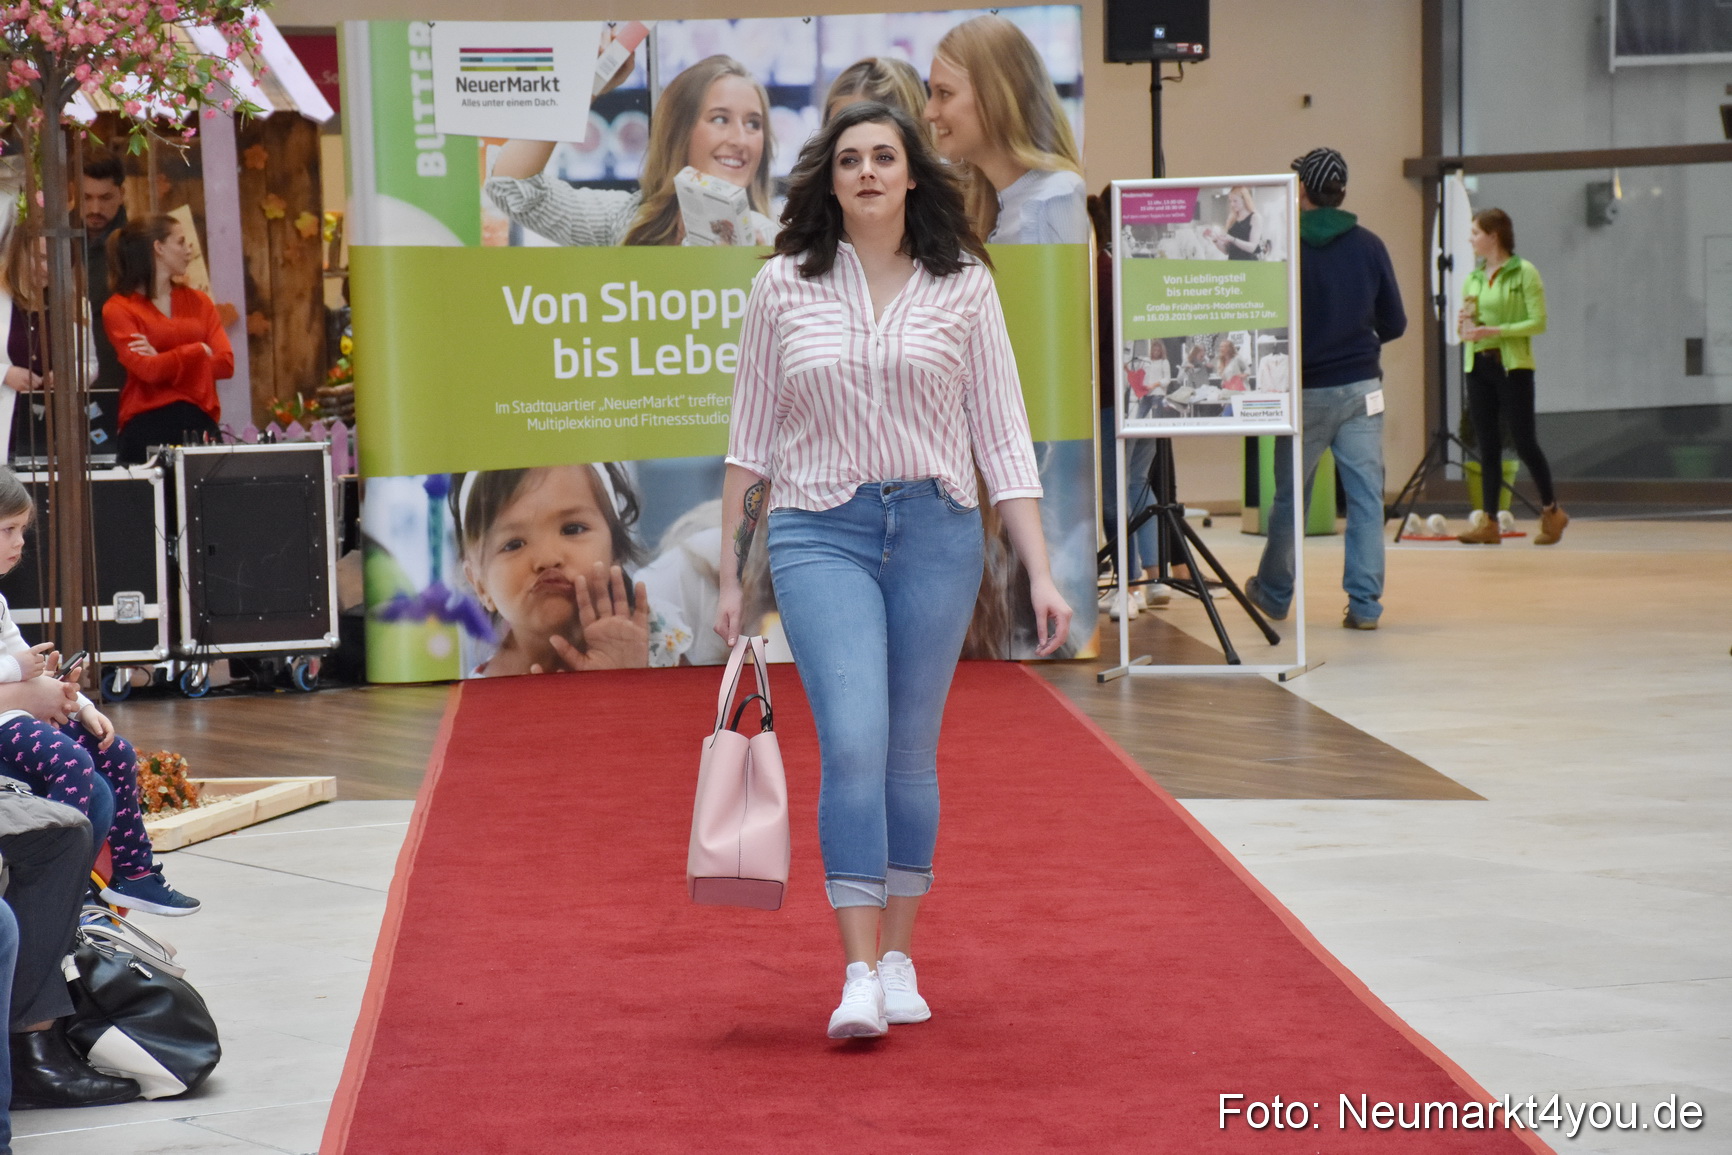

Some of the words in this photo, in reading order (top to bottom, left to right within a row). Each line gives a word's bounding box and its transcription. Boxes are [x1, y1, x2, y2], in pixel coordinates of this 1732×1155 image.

[456, 76, 560, 93] NeuerMarkt
[461, 98, 481, 107] Alles
[482, 98, 504, 107] unter
[506, 98, 533, 107] einem
[534, 98, 559, 107] Dach.
[1163, 275, 1183, 285] Von
[1184, 273, 1247, 285] Lieblingsteil
[1166, 287, 1181, 297] bis
[1183, 287, 1212, 296] neuer
[1214, 285, 1243, 297] Style.
[502, 285, 588, 325] Von
[600, 277, 756, 329] Shopp
[1146, 303, 1170, 312] Große
[1171, 301, 1264, 312] Frühjahrs-Modenschau
[1133, 314, 1146, 322] am
[1146, 312, 1192, 322] 16.03.2019
[1210, 312, 1219, 320] 11
[1220, 311, 1235, 320] Uhr
[1236, 311, 1249, 319] bis
[1250, 310, 1260, 318] 17
[553, 337, 619, 379] bis
[495, 402, 510, 414] Im
[512, 398, 596, 415] Stadtquartier
[688, 393, 733, 407] treffen
[527, 415, 612, 432] Multiplexkino
[614, 413, 639, 427] und
[641, 412, 730, 427] Fitnessstudio
